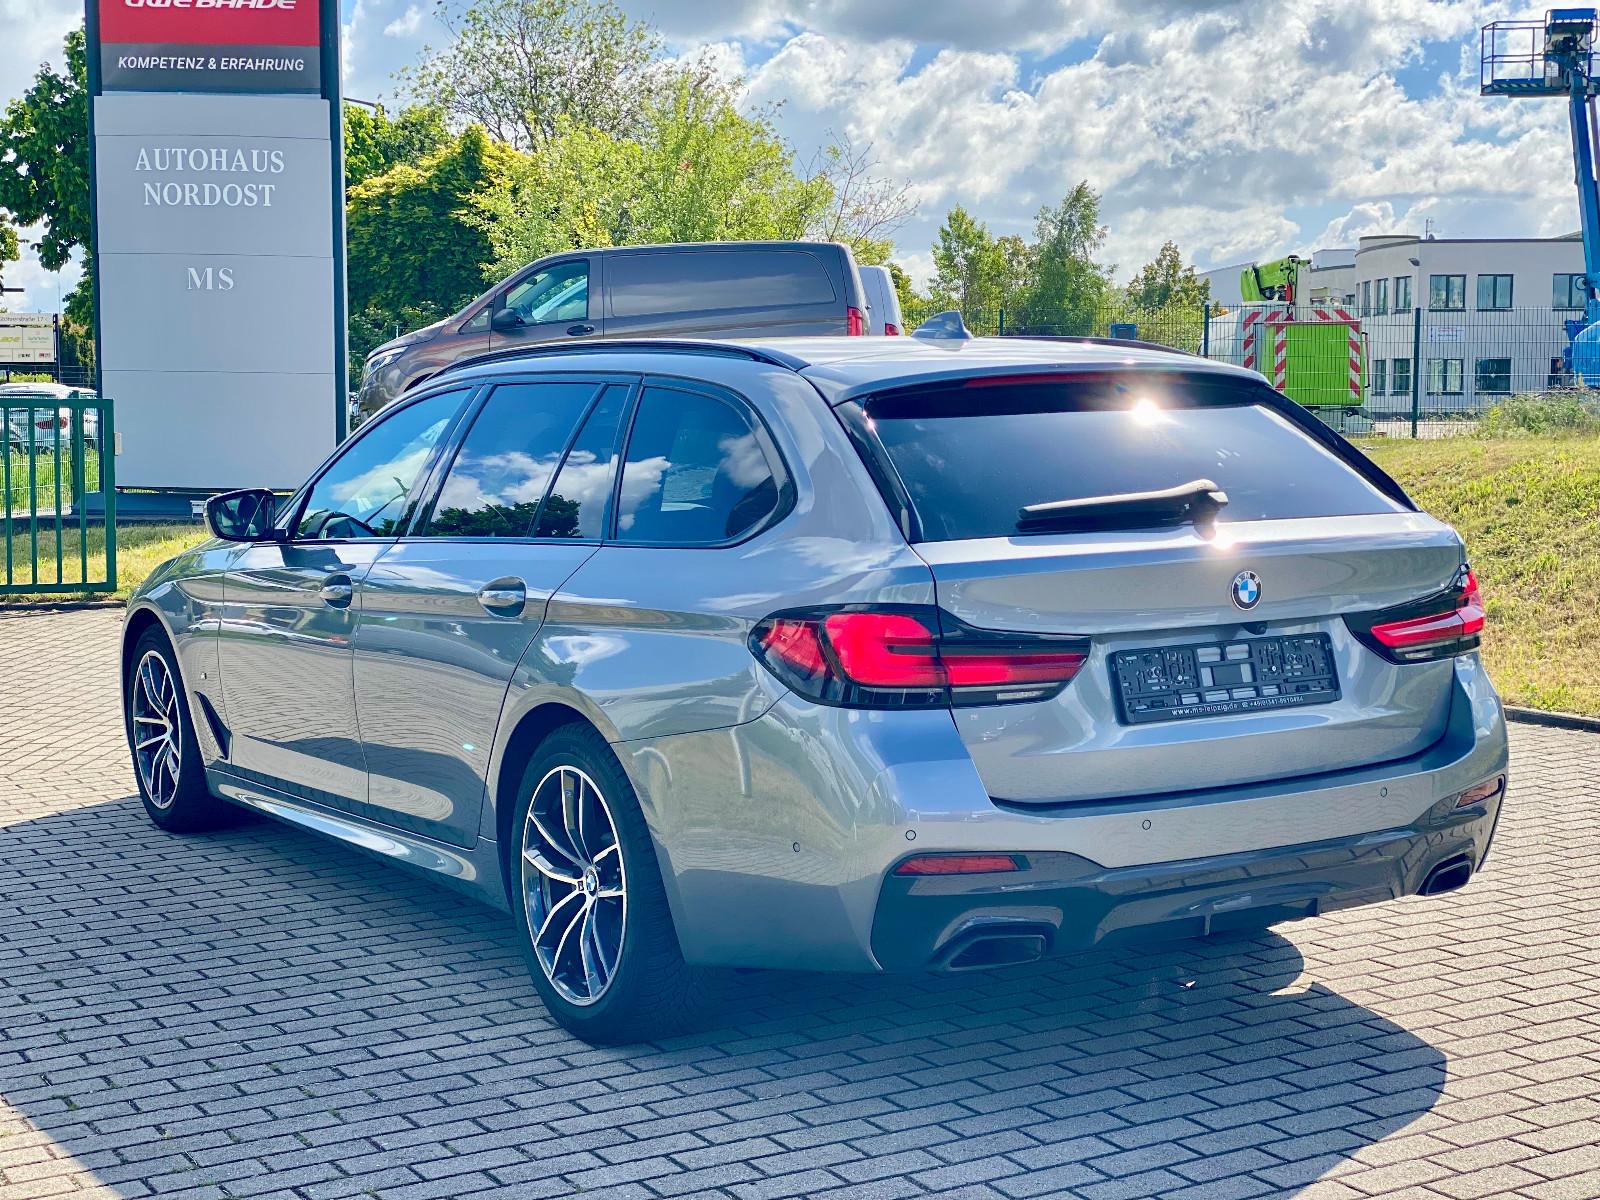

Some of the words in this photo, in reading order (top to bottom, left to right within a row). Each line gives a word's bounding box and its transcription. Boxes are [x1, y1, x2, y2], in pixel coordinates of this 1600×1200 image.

[118, 56, 205, 70] KOMPETENZ
[208, 57, 217, 70] &
[220, 57, 305, 71] ERFAHRUNG
[135, 147, 285, 174] AUTOHAUS
[143, 182, 276, 207] NORDOST
[187, 267, 234, 291] MS
